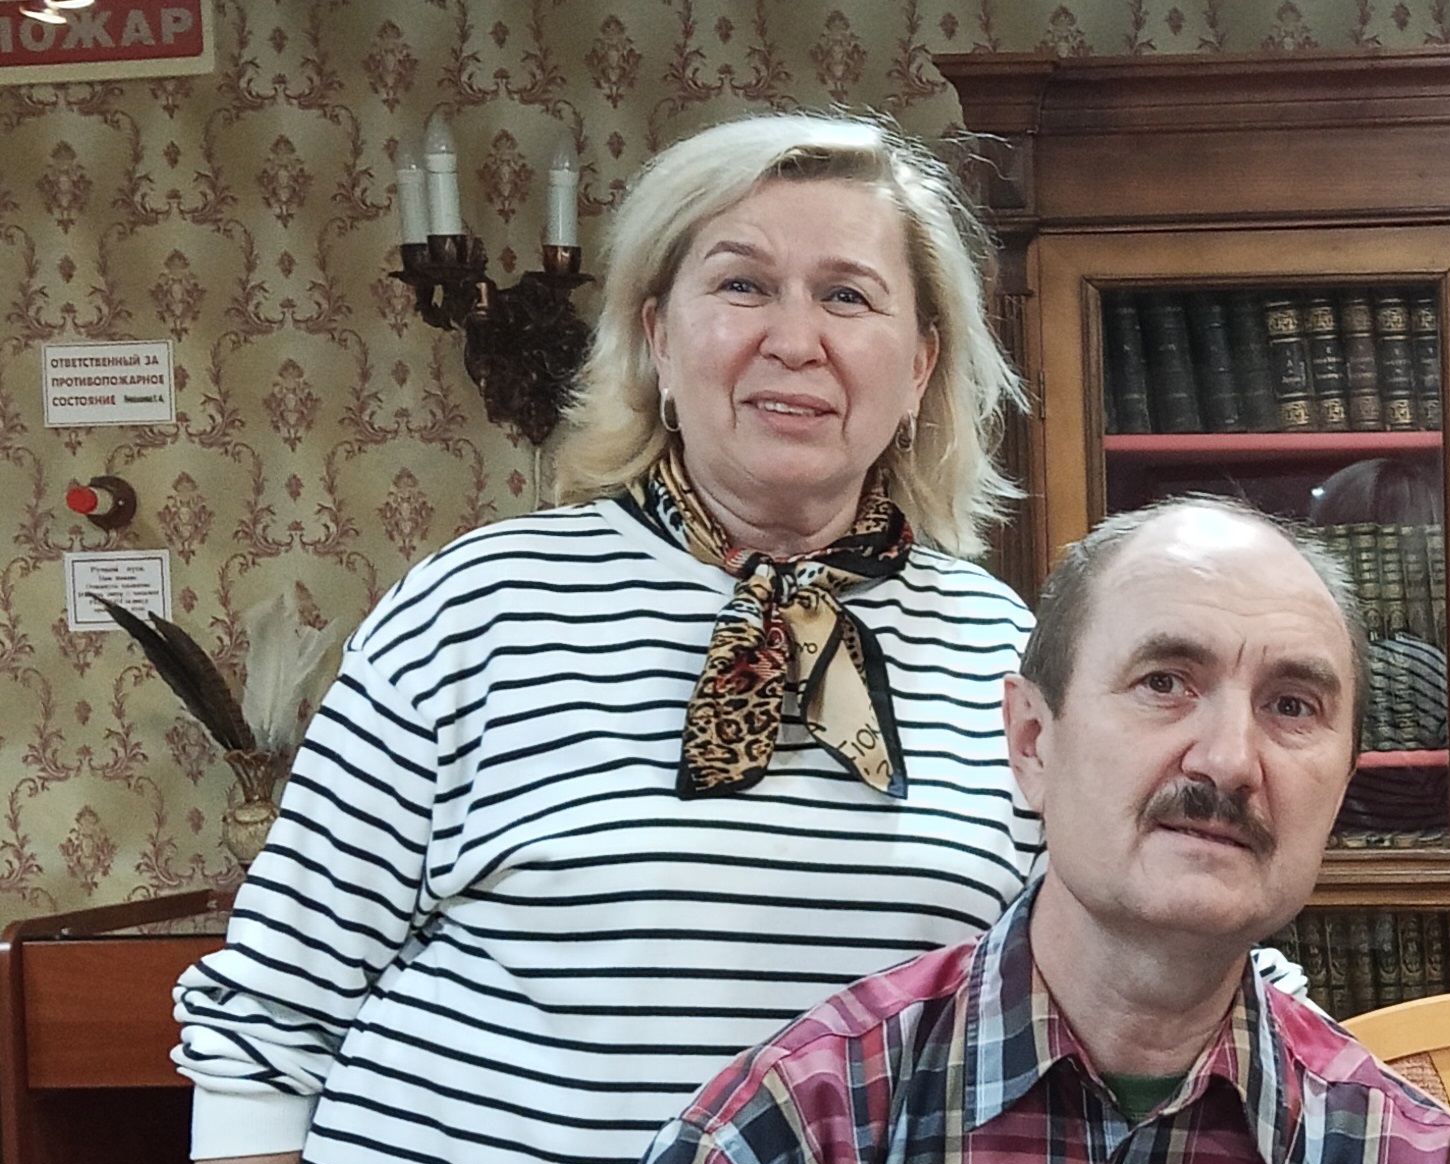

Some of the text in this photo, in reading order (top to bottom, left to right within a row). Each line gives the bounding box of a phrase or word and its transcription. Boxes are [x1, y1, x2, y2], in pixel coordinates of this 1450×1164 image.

[51, 355, 159, 368] ОТВЕТСТВЕННЫЙ ЗА
[51, 374, 164, 387] ПРОТИВОПОЖАРНОЕ
[52, 395, 116, 407] СОСТОЯНИЕ
